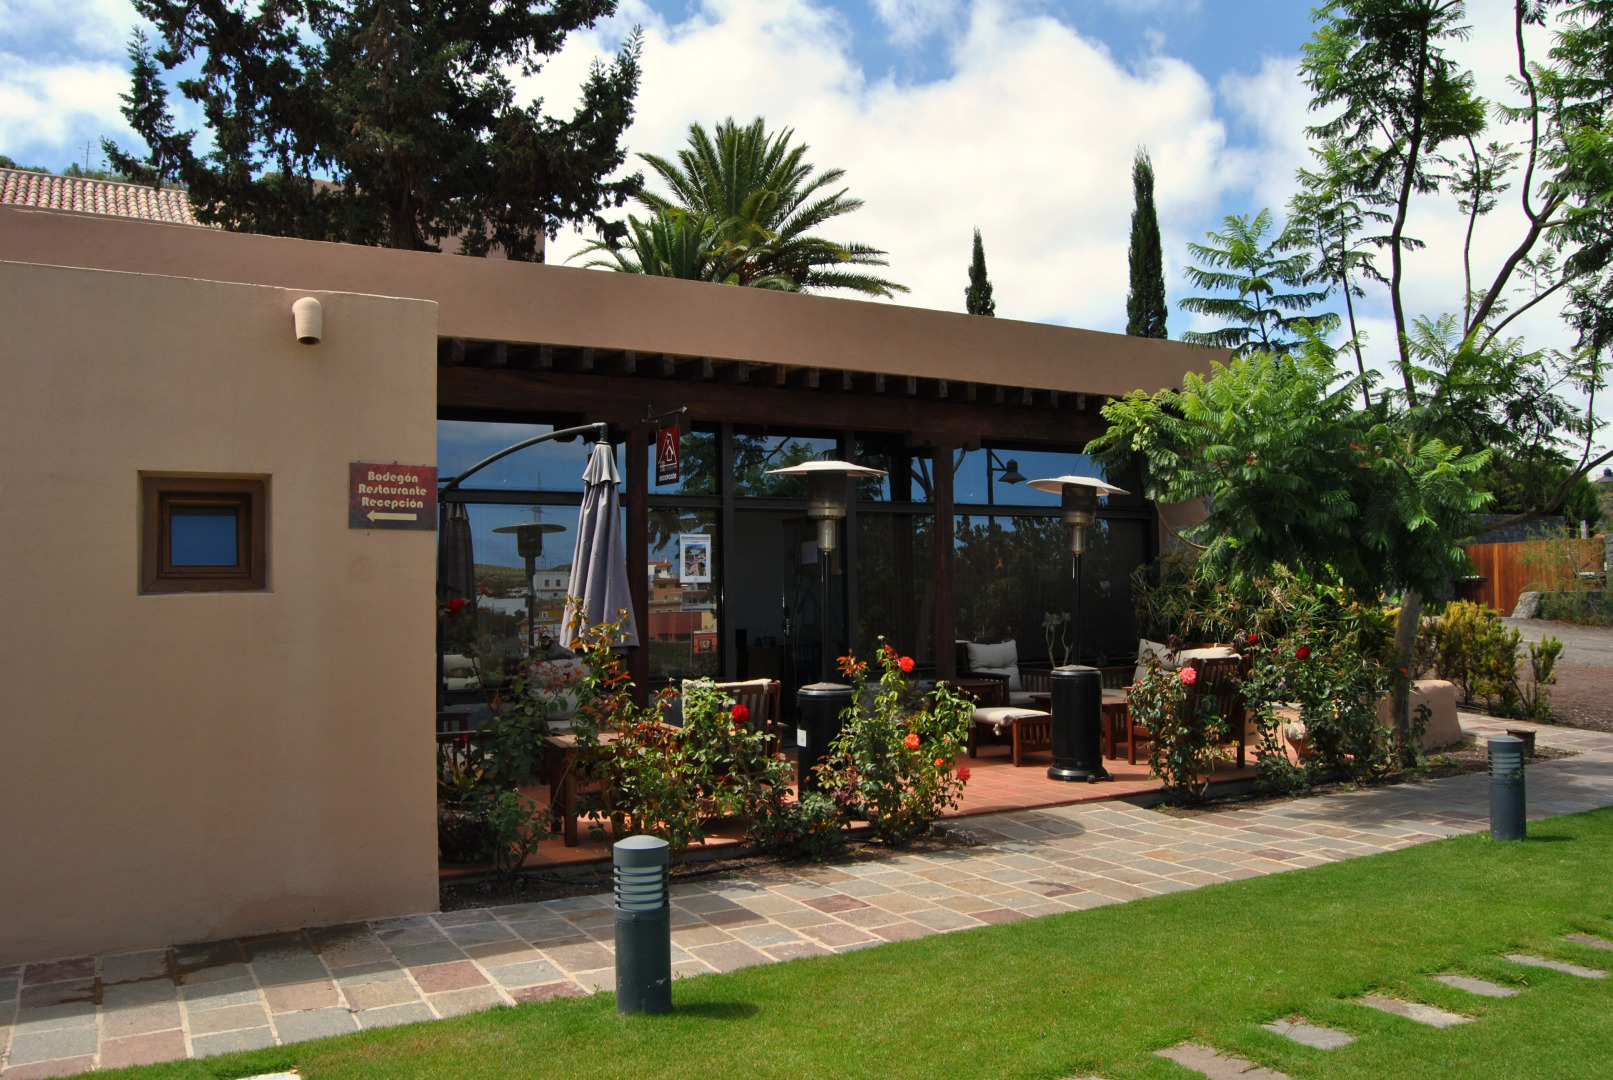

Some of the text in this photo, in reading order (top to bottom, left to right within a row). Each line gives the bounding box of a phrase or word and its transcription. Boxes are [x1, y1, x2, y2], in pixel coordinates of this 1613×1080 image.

[368, 471, 418, 485] Bodegón
[358, 483, 427, 496] Restaurante
[361, 496, 424, 510] Recepción
